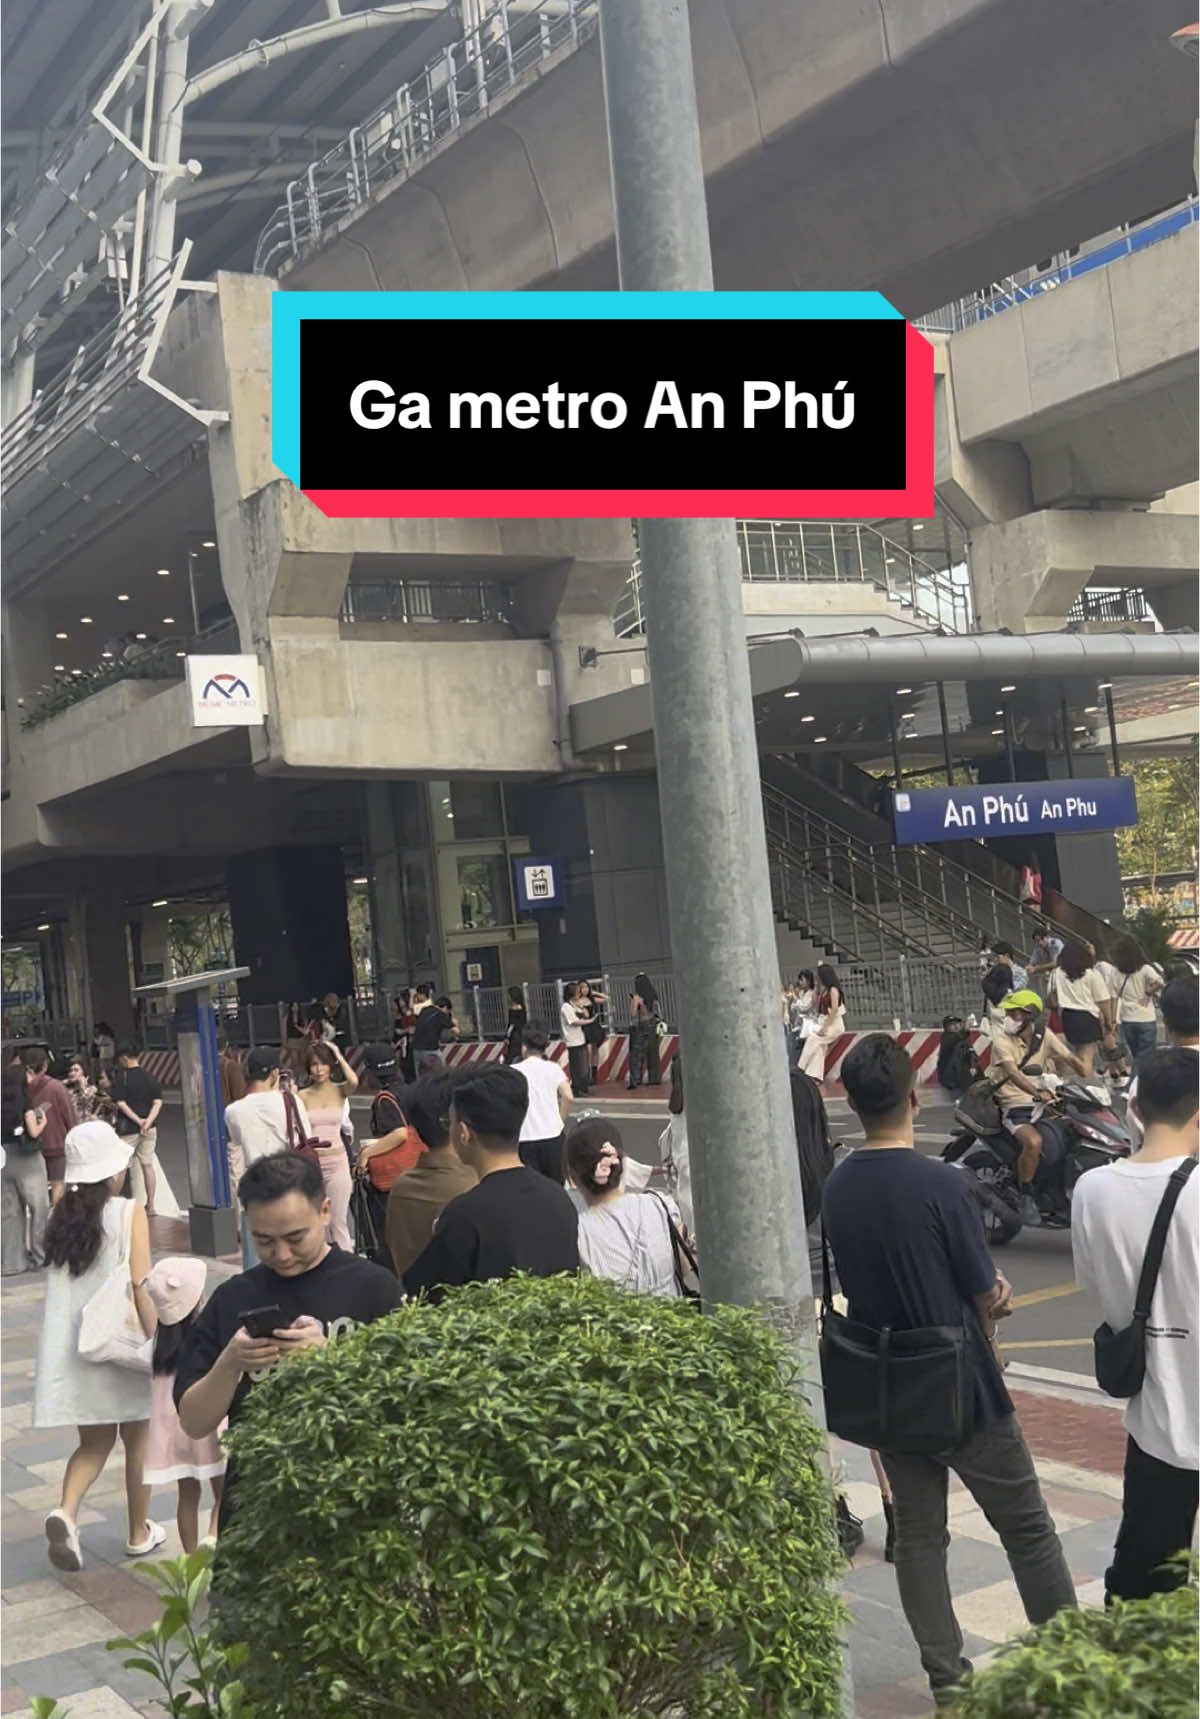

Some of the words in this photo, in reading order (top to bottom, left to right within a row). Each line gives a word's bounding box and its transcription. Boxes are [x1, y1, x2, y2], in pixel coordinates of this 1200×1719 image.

[943, 799, 977, 828] An
[982, 794, 1029, 825] Phú
[1040, 799, 1063, 819] An
[1066, 797, 1097, 817] Phu
